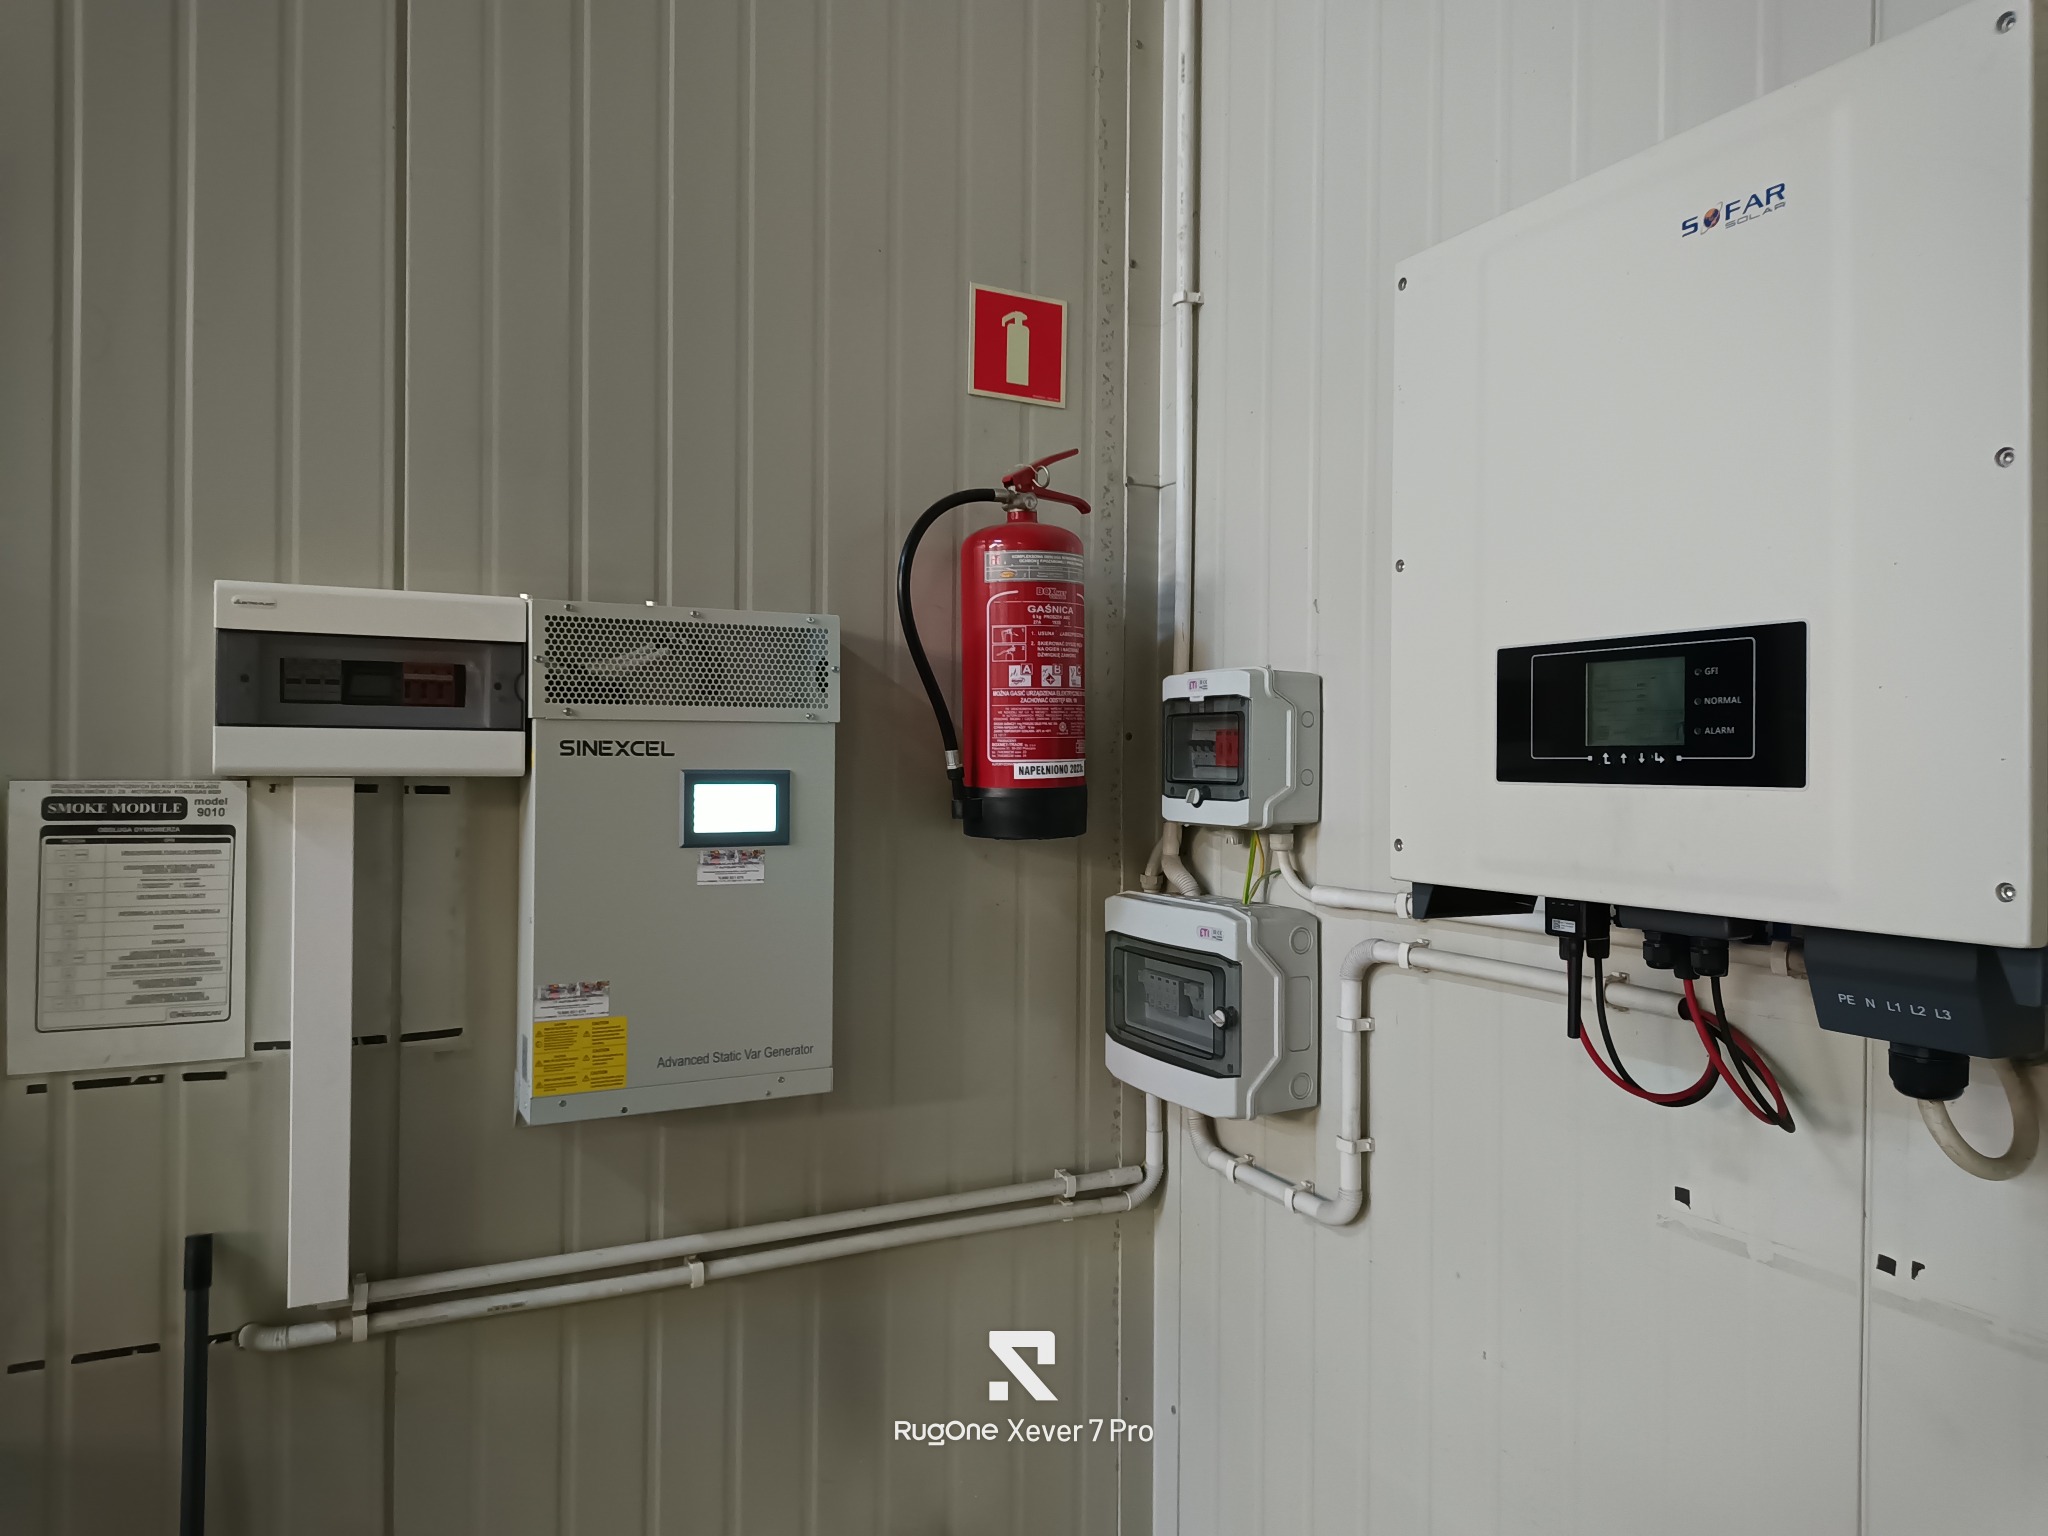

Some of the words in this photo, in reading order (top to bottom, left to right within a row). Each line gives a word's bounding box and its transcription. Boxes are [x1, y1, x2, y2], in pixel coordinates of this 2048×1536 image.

[1682, 183, 1785, 238] SOFAR
[1725, 201, 1786, 229] SOLAR
[1027, 604, 1074, 615] GAŚNICA
[1022, 665, 1031, 674] A
[1054, 665, 1061, 674] B
[1704, 667, 1719, 675] GFI
[1703, 696, 1742, 705] NORMAL
[1704, 726, 1735, 735] ALARM
[559, 739, 676, 757] SINEXCEL
[1018, 764, 1069, 776] NAPEŁNIONO
[47, 802, 108, 815] SMOKE
[111, 802, 183, 814] MODULE
[194, 797, 228, 806] model
[197, 807, 226, 817] 9010
[1838, 993, 1856, 1005] PE
[1865, 998, 1876, 1009] N
[1886, 1001, 1902, 1012] L1
[1909, 1004, 1927, 1017] L2
[1934, 1008, 1952, 1021] L3
[656, 1053, 710, 1069] Advanced
[712, 1050, 742, 1063] Static
[744, 1048, 761, 1060] Var
[764, 1044, 814, 1059] Generator
